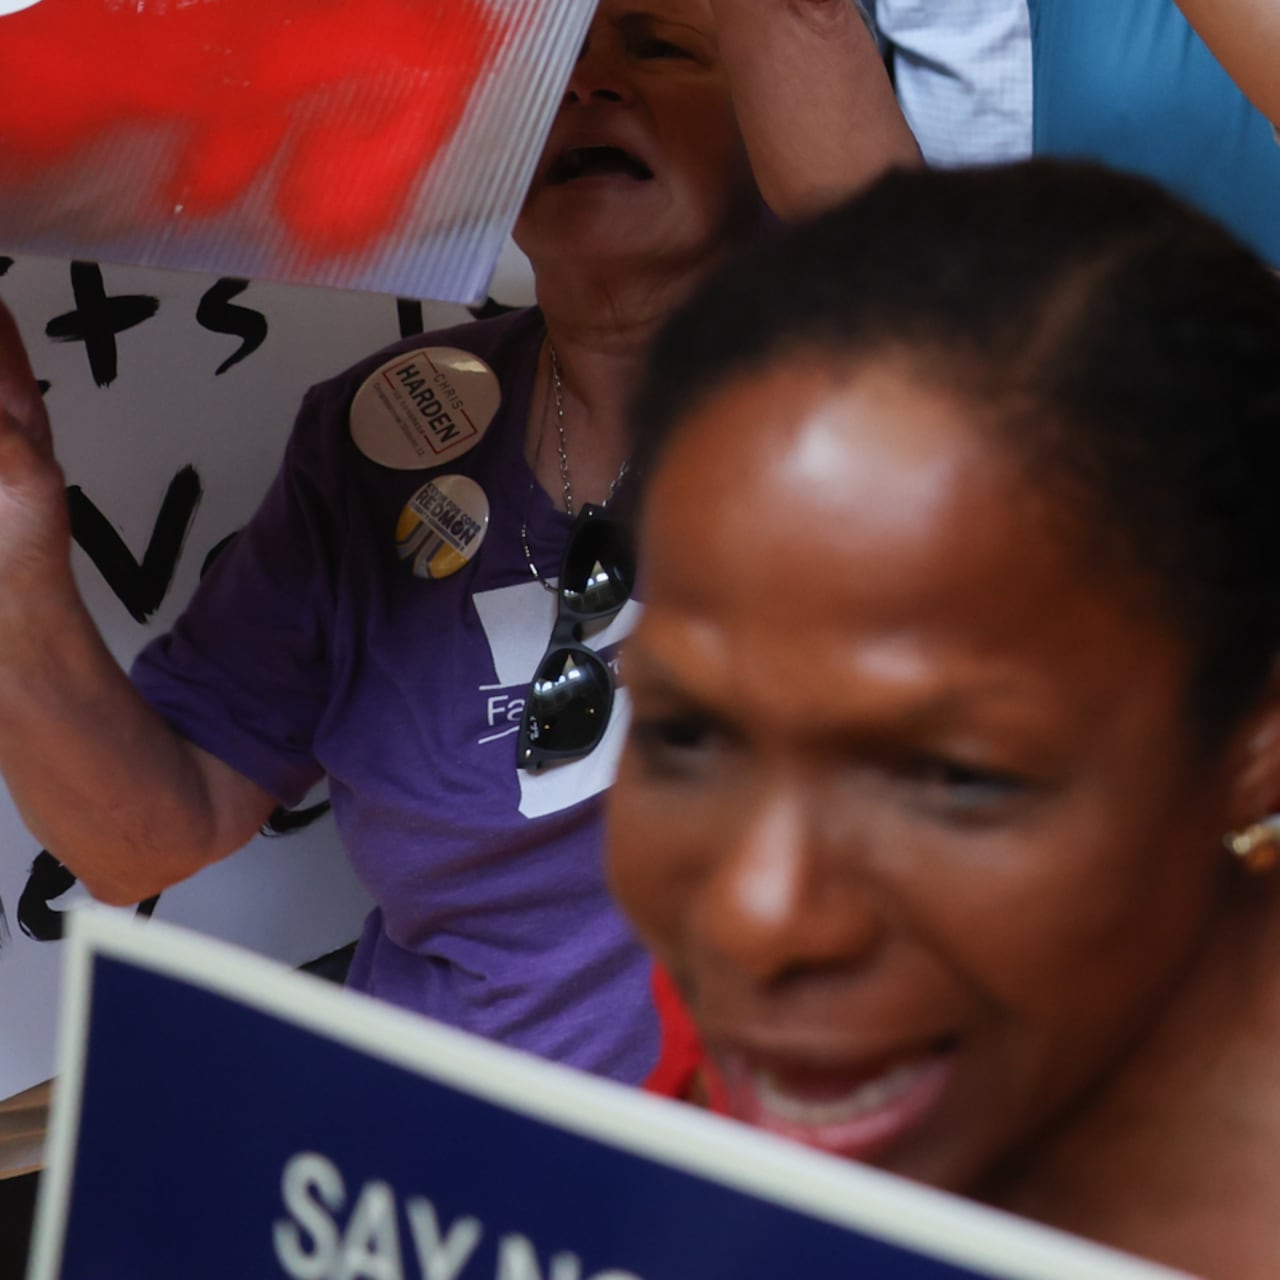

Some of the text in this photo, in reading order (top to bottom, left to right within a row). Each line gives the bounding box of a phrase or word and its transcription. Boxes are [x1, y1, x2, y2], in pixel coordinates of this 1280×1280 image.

[396, 363, 461, 444] HARDEN
[433, 373, 464, 411] CHRIS
[416, 489, 477, 547] REDMON
[272, 1150, 484, 1280] SAY
